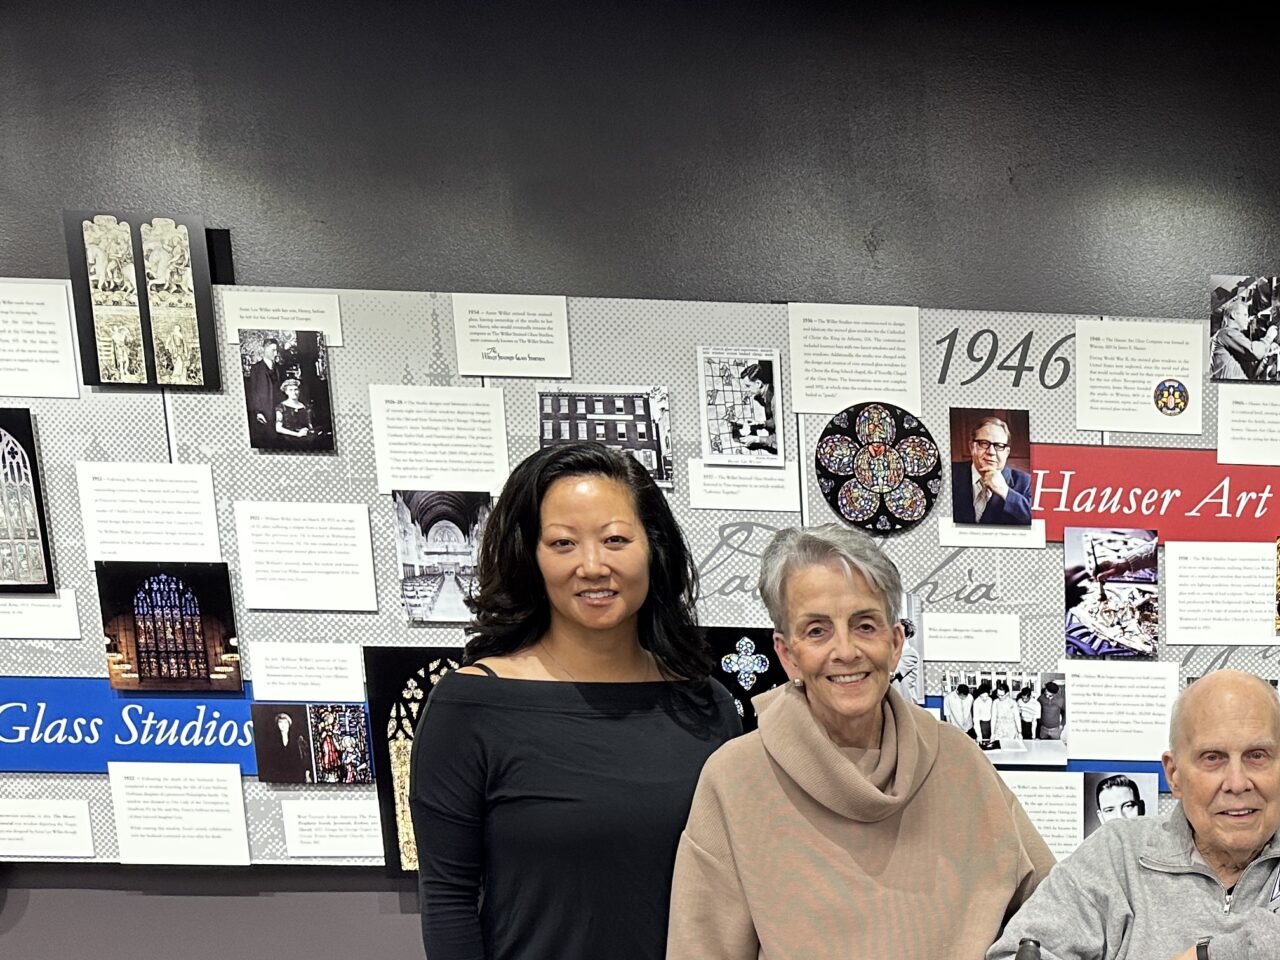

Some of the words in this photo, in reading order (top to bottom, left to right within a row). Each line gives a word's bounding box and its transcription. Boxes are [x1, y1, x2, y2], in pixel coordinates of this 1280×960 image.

[936, 328, 1076, 390] 1946
[1031, 470, 1180, 516] Hauser
[1185, 477, 1273, 518] Art
[0, 702, 103, 744] Glass
[115, 704, 253, 747] Studios
